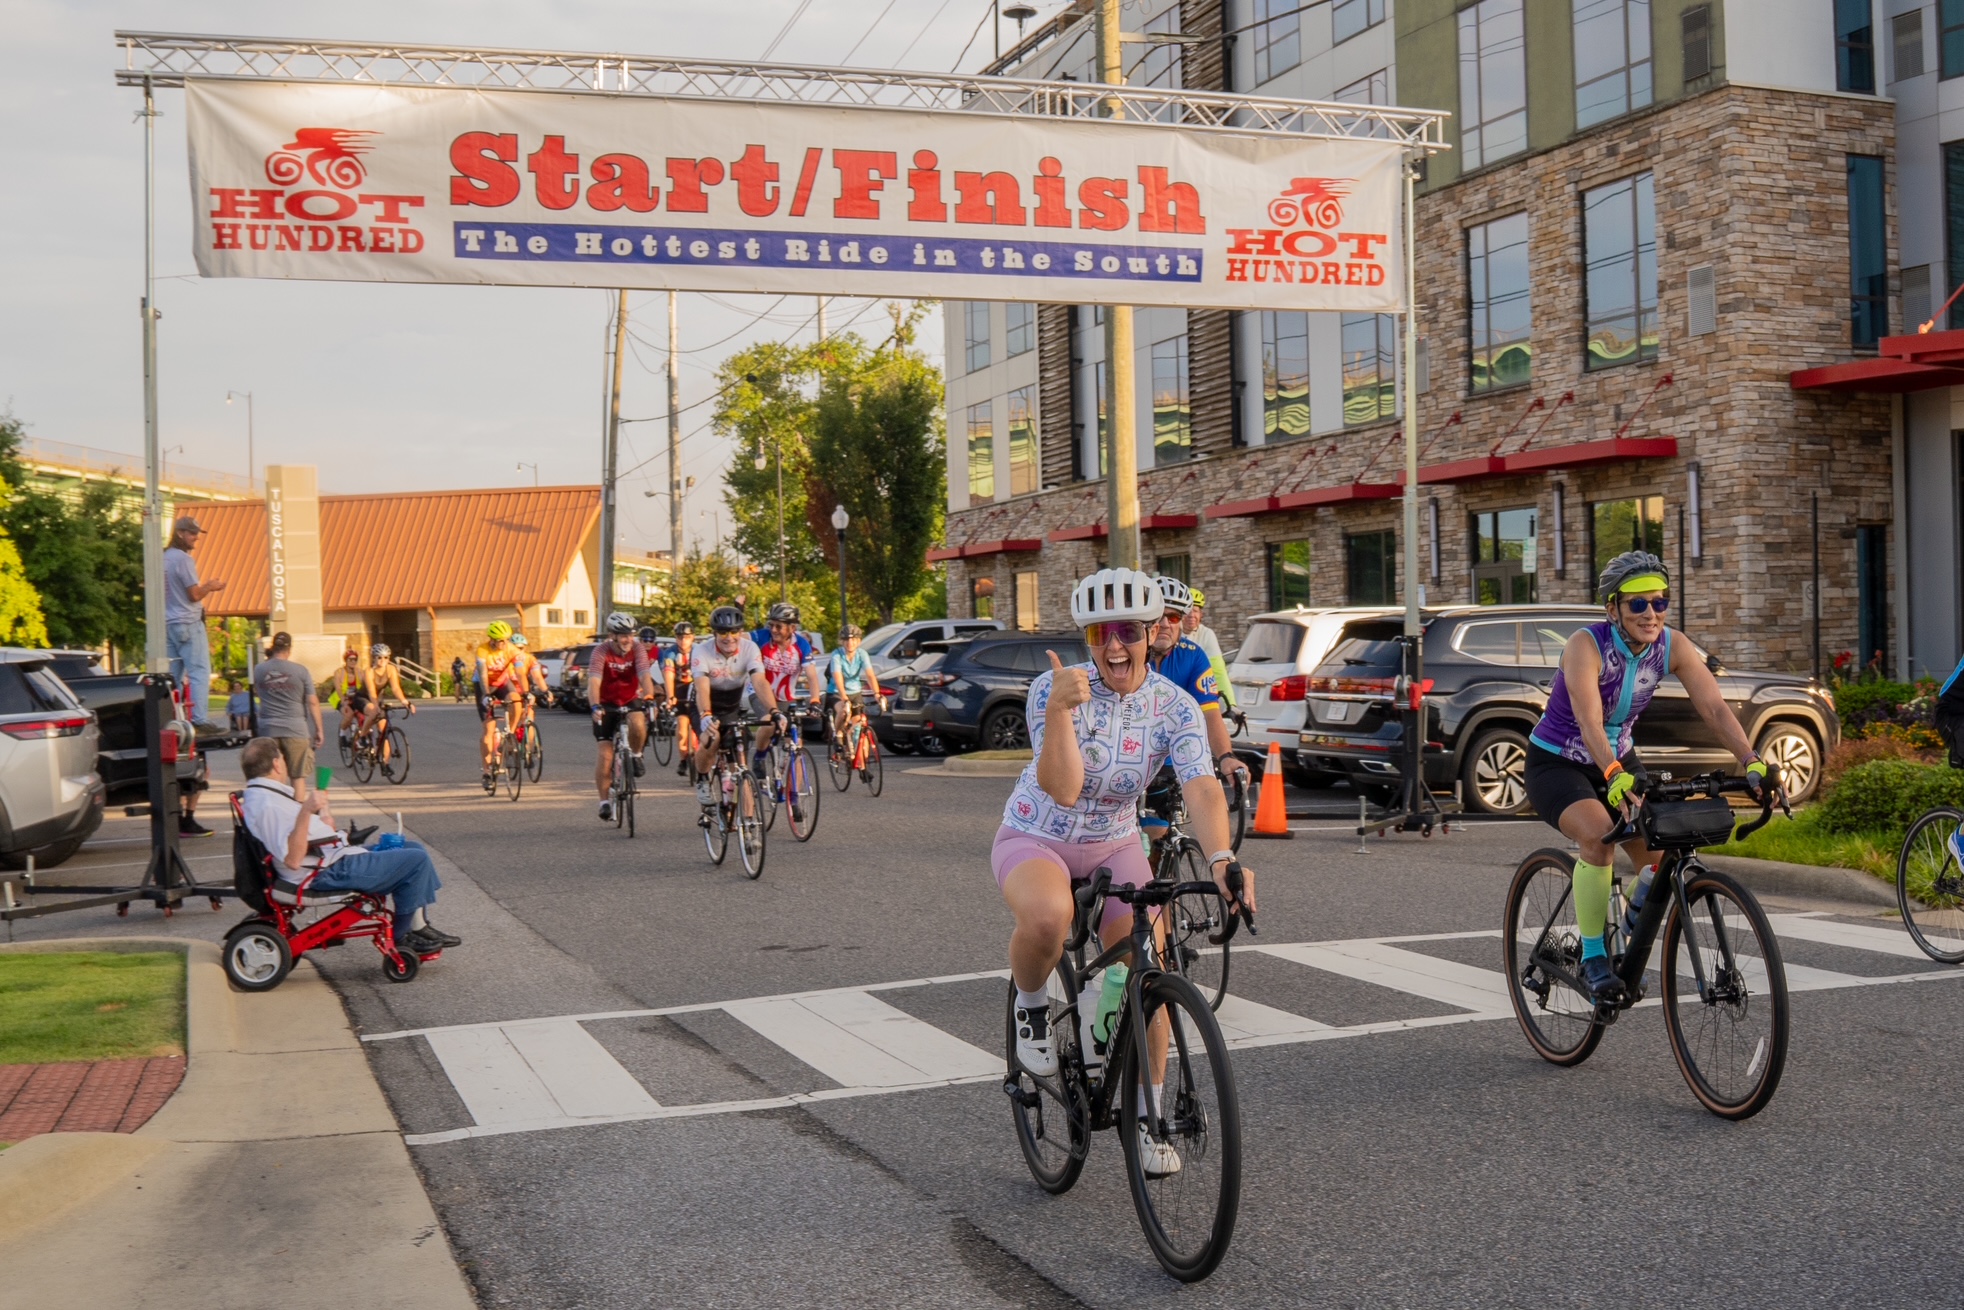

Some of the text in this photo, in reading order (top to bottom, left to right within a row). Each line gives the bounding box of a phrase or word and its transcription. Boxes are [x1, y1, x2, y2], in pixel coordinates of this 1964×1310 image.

[450, 131, 1206, 235] Start/Finish
[210, 188, 424, 224] HOT
[212, 223, 424, 254] HUNDRED
[460, 229, 1199, 277] The Hottest Ride in the South
[1226, 229, 1387, 260] HOT
[1226, 258, 1386, 286] HUNDRED
[271, 488, 286, 612] TUSCALOOSA
[1122, 703, 1134, 731] METEOR
